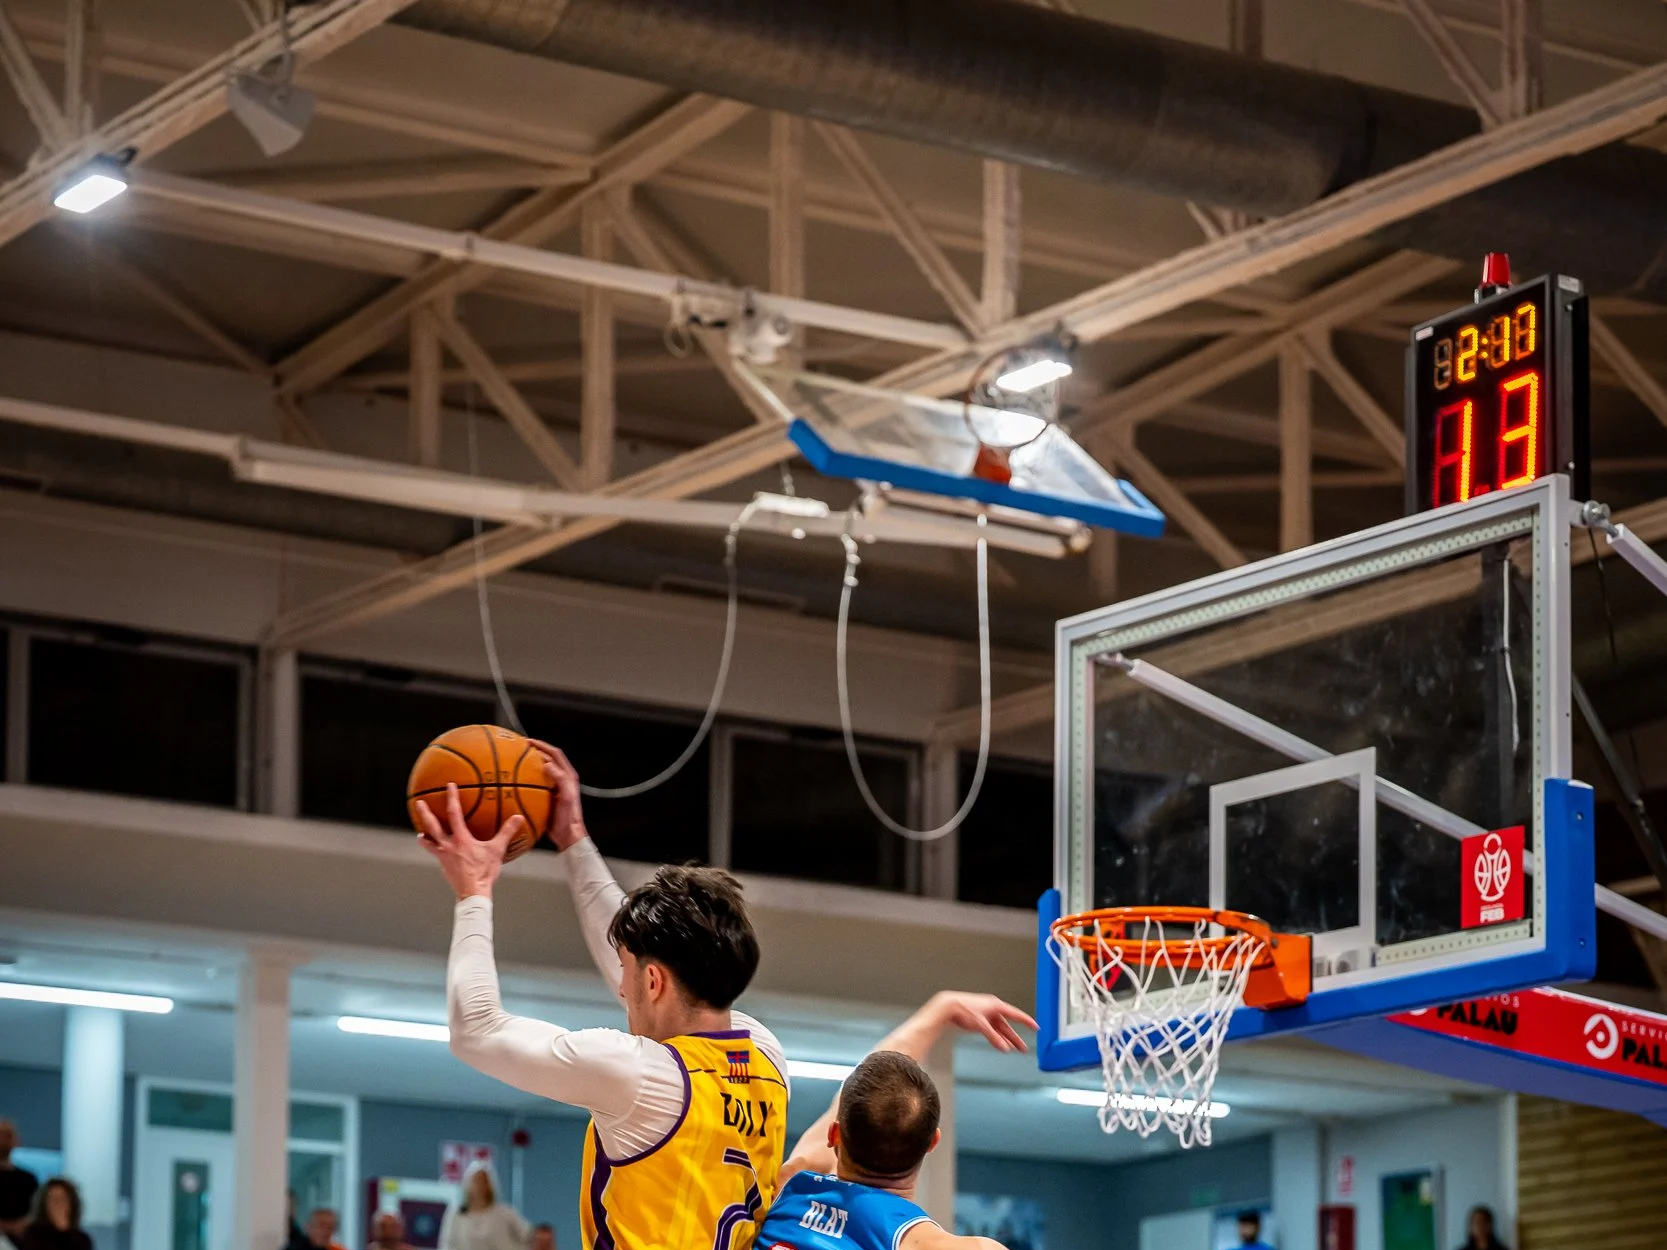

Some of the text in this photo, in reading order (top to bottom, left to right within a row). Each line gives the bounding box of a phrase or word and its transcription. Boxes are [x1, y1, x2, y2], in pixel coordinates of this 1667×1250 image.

[1457, 304, 1536, 382] 2:17
[1460, 372, 1539, 503] 13
[1437, 1001, 1518, 1035] PALAU
[1621, 1020, 1667, 1042] SERVI
[1622, 1037, 1667, 1071] PAL
[798, 1200, 849, 1239] BLAT
